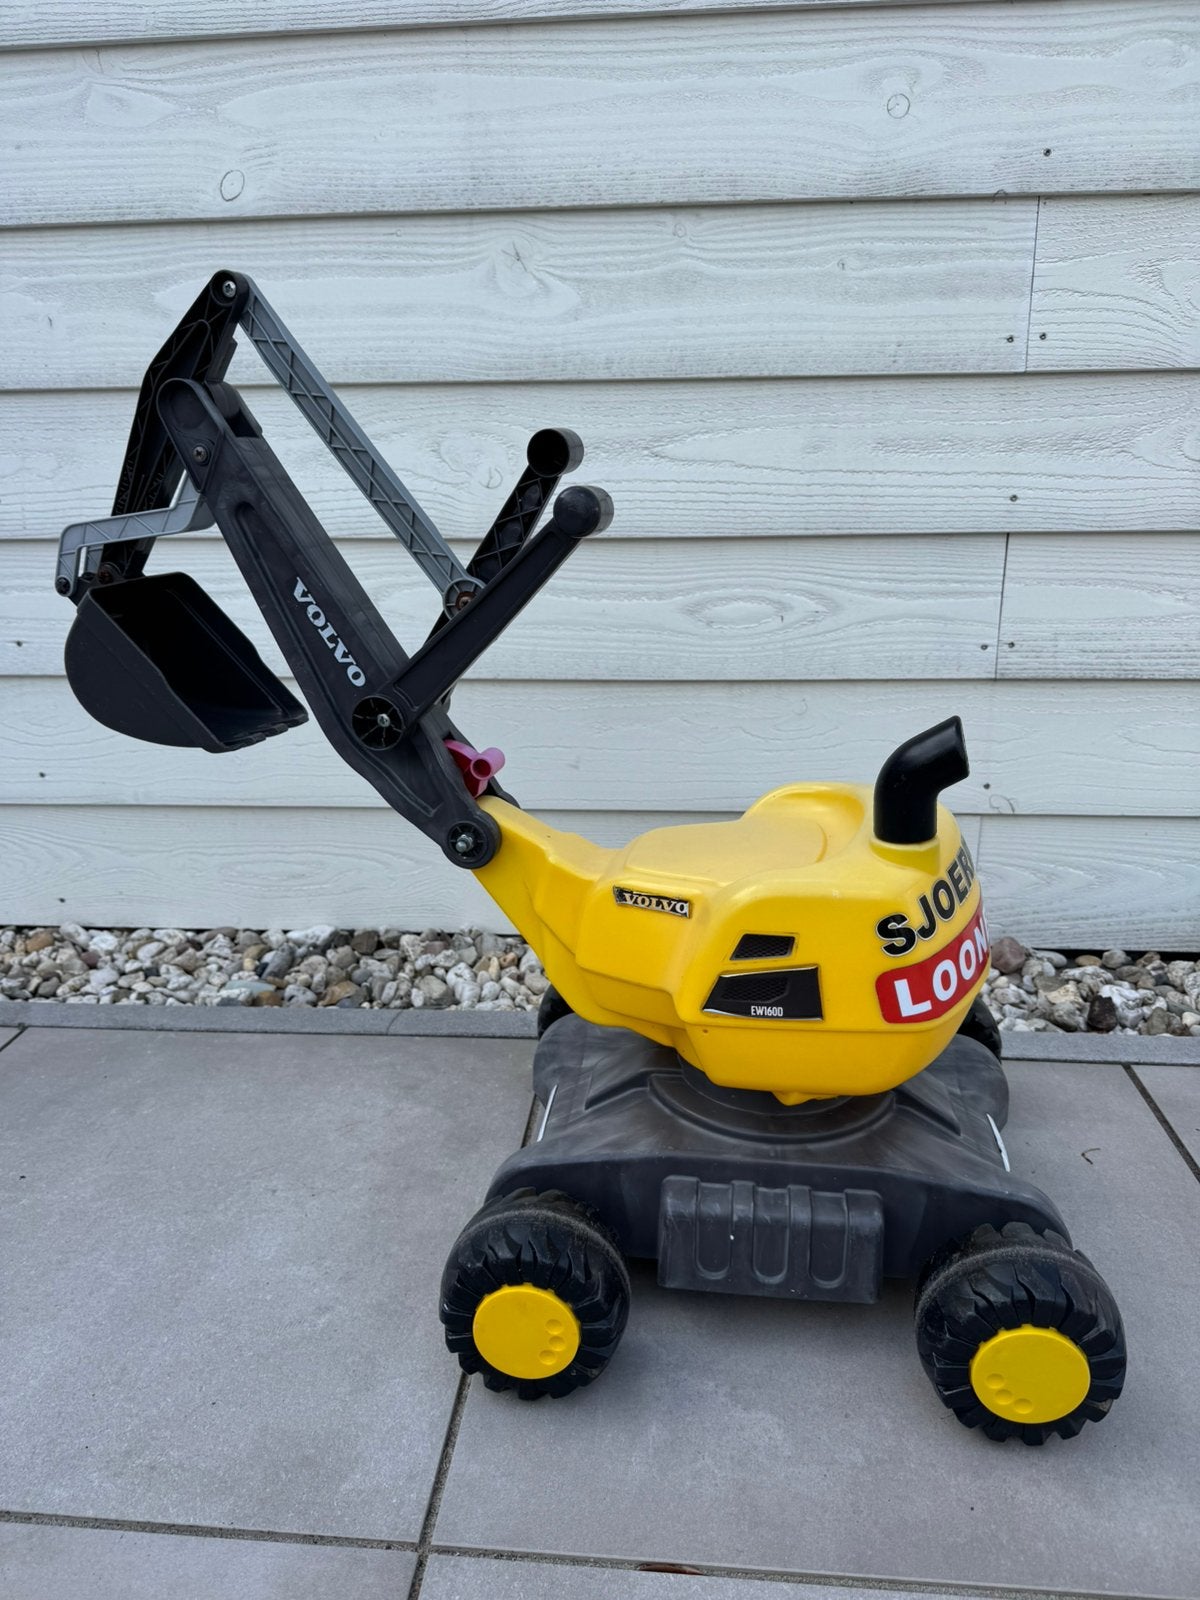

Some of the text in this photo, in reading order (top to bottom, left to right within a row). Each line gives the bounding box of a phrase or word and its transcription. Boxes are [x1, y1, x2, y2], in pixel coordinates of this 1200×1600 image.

[293, 576, 367, 688] VOLVO
[622, 892, 690, 915] VOLVO
[876, 835, 975, 957] SJOER
[894, 904, 989, 1017] LOON
